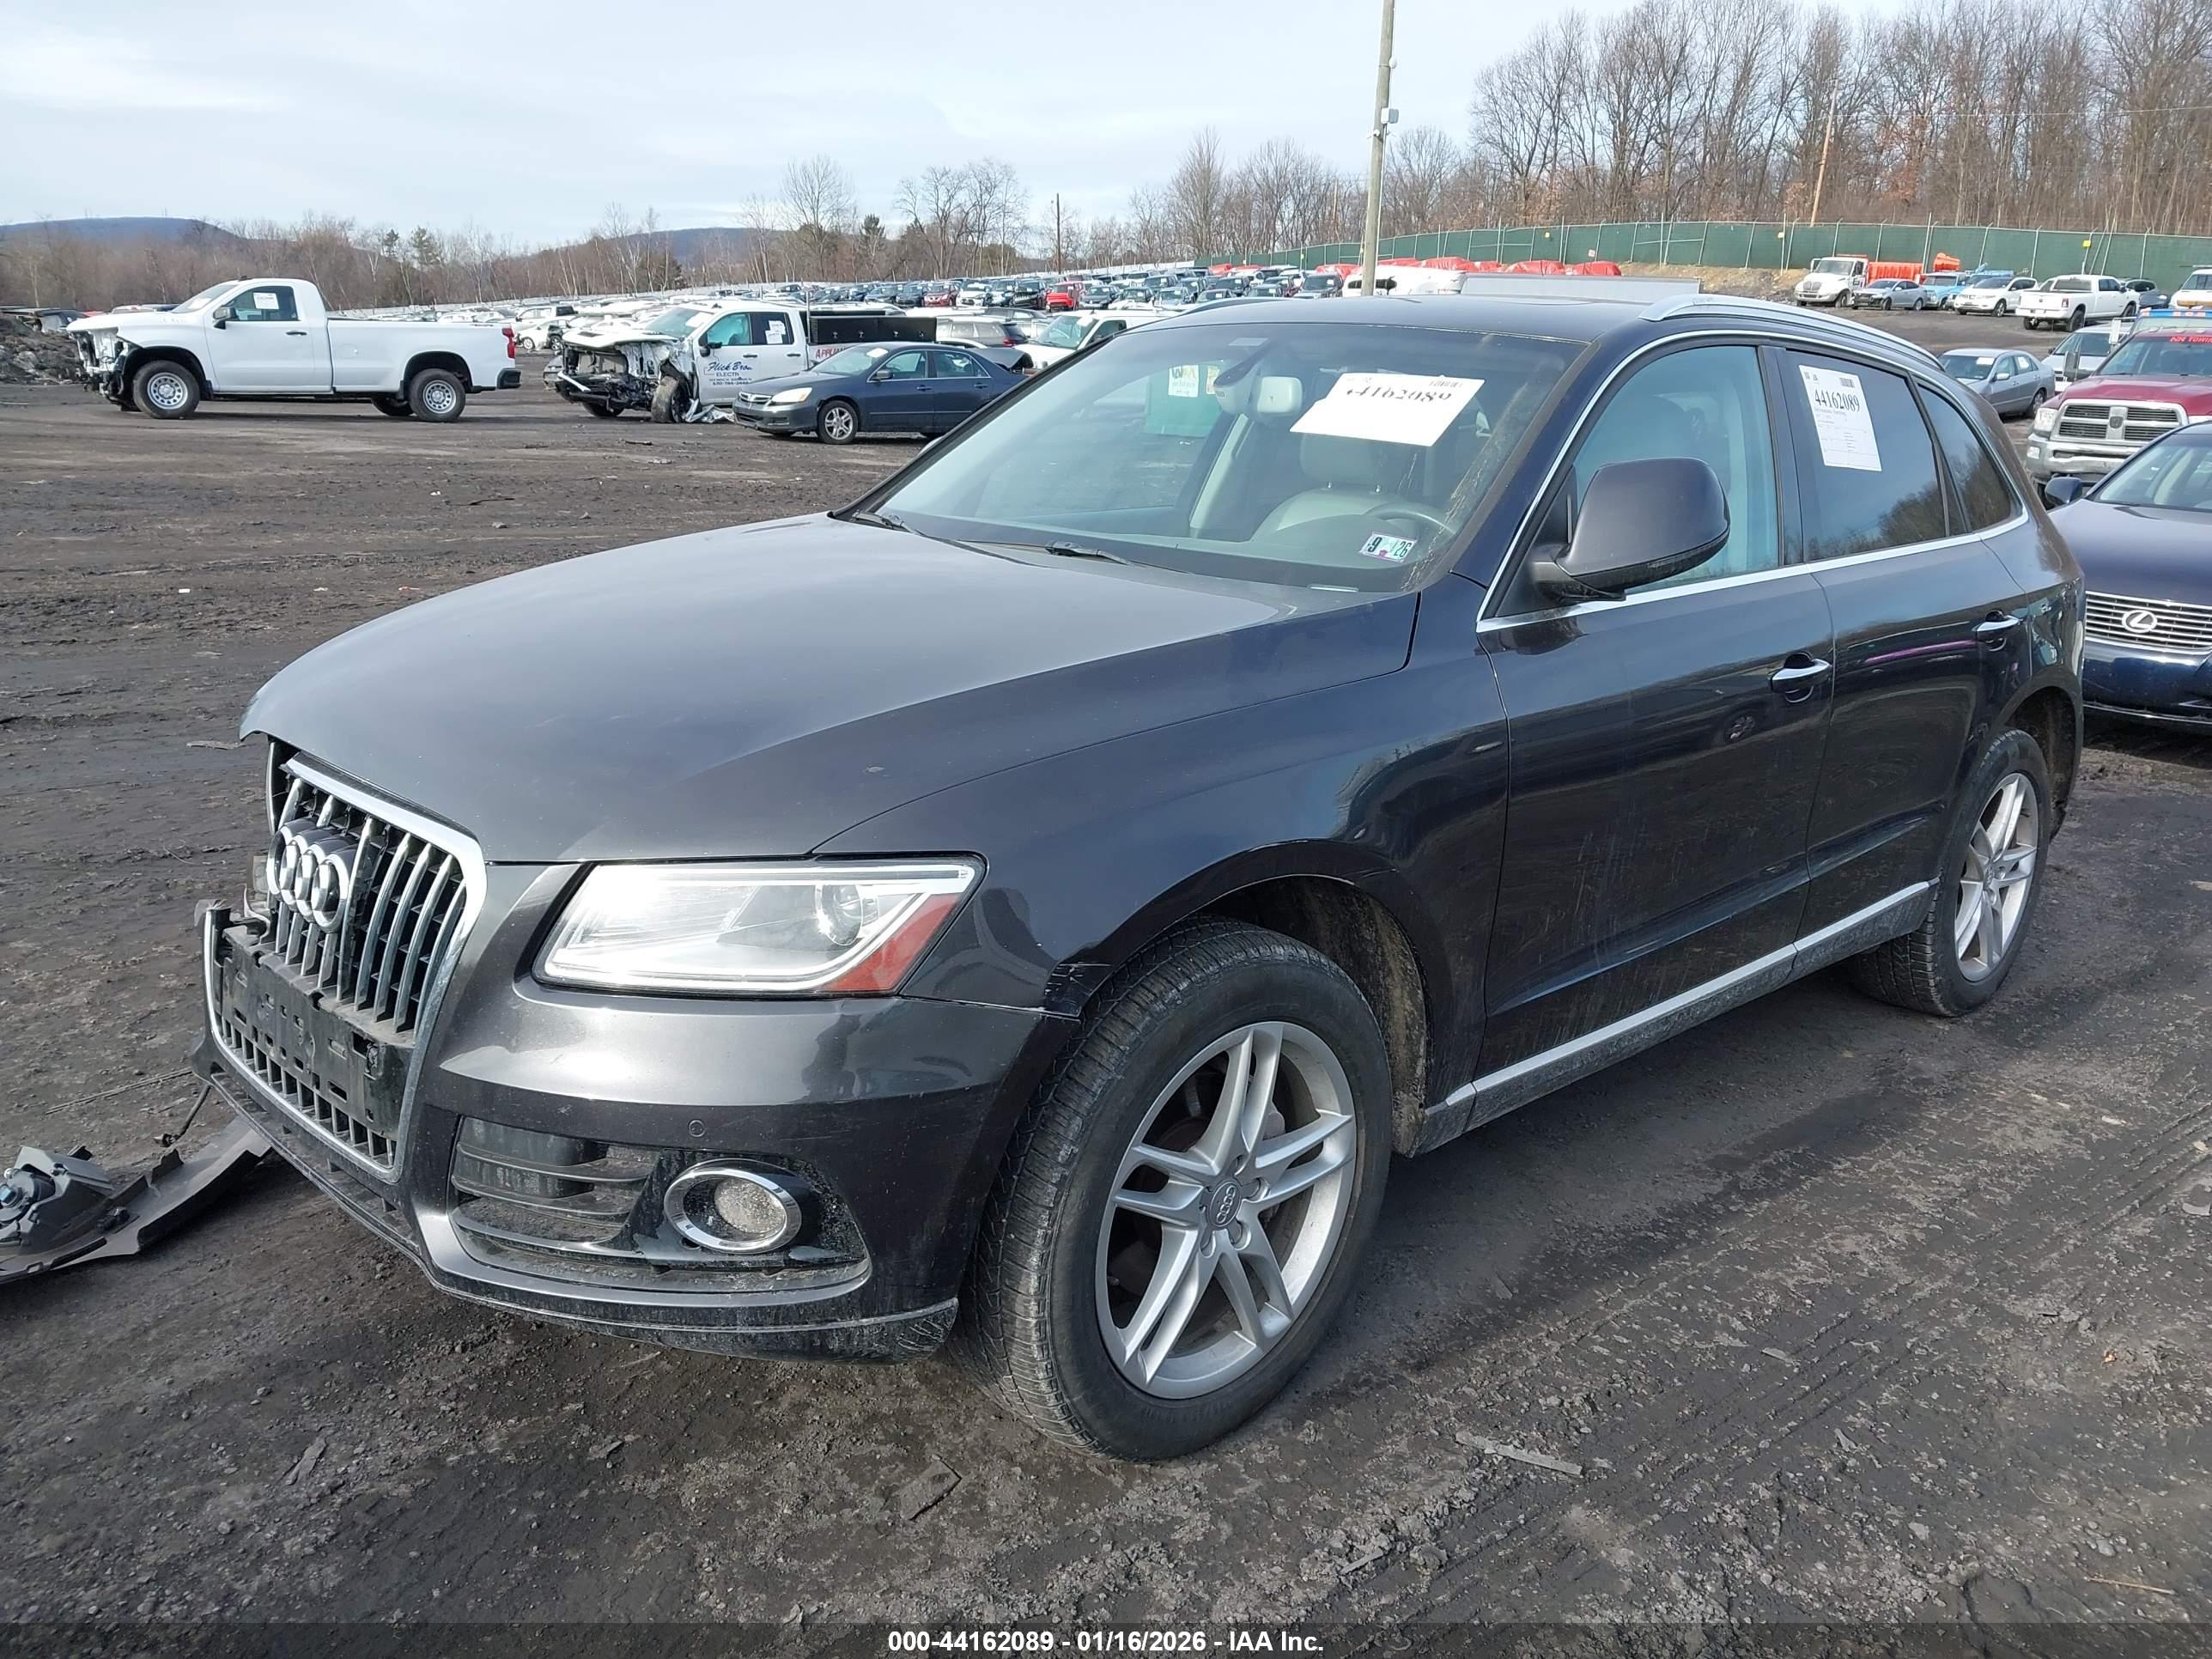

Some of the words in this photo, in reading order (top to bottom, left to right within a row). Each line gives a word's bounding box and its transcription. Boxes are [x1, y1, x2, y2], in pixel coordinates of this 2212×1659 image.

[1814, 388, 1861, 412] 44162089
[1367, 536, 1383, 553] 9
[1393, 540, 1413, 558] 26
